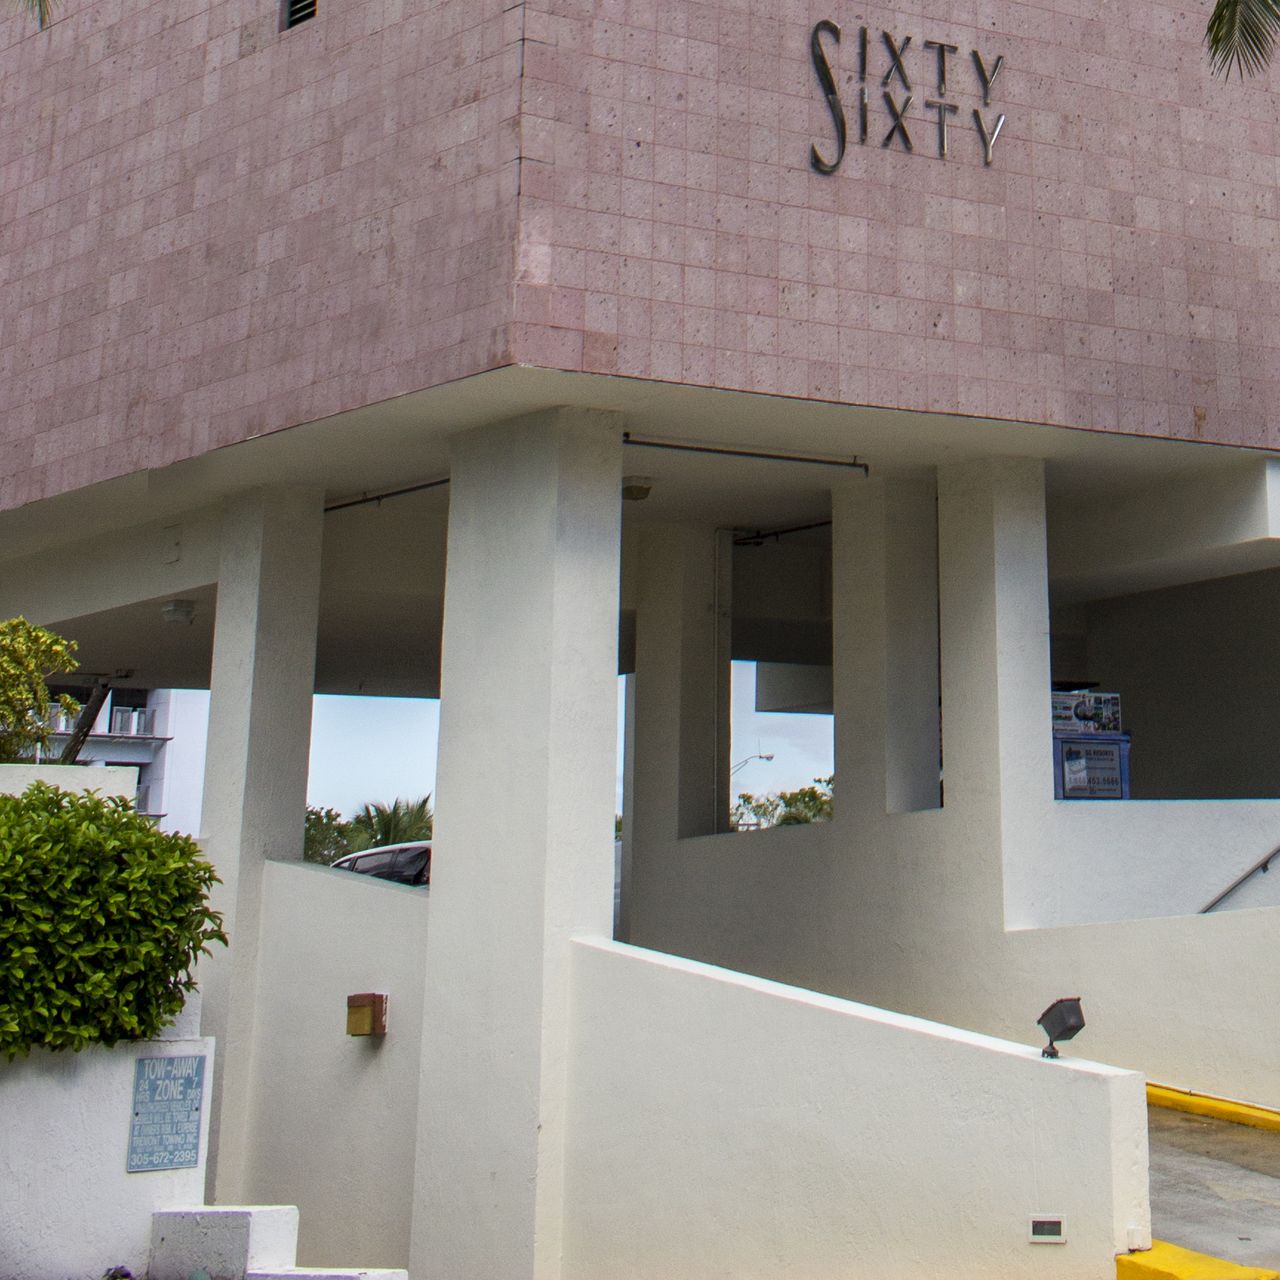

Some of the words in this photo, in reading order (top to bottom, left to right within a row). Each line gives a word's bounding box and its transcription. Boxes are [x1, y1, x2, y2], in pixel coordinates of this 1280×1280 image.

[144, 1057, 199, 1078] TOW-AWAY
[139, 1080, 149, 1090] 24
[155, 1079, 184, 1100] ZONE
[130, 1151, 196, 1165] 305-672-2395
